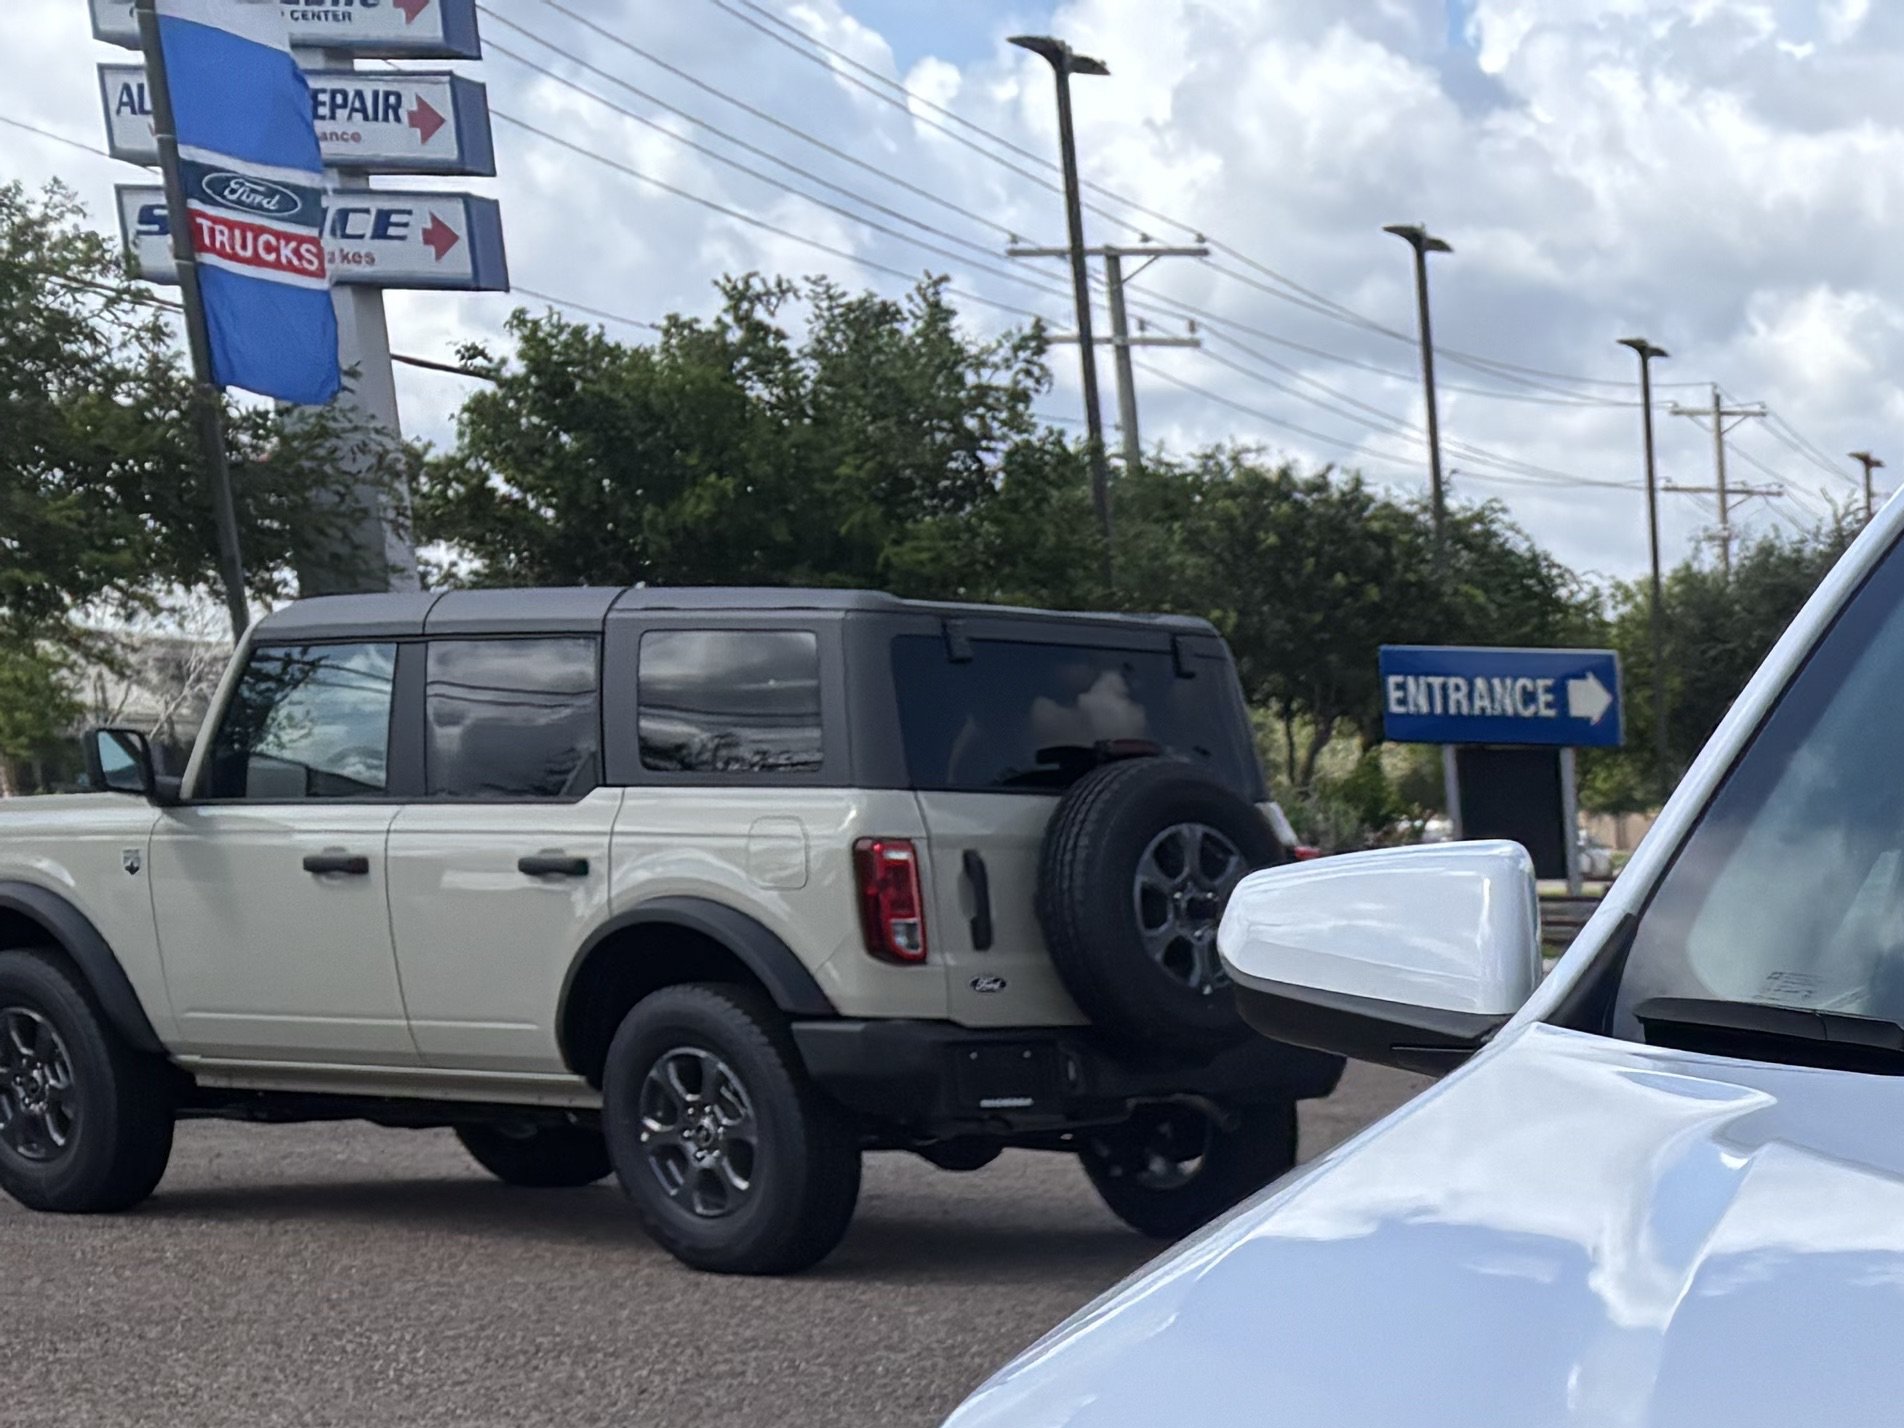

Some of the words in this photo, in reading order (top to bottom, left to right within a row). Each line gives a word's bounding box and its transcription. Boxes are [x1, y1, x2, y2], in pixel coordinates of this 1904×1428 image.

[290, 9, 352, 22] CENTER
[311, 88, 403, 124] EPAIR
[224, 178, 279, 211] Ford
[196, 217, 320, 272] TRUCKS
[1387, 674, 1559, 717] ENTRANCE
